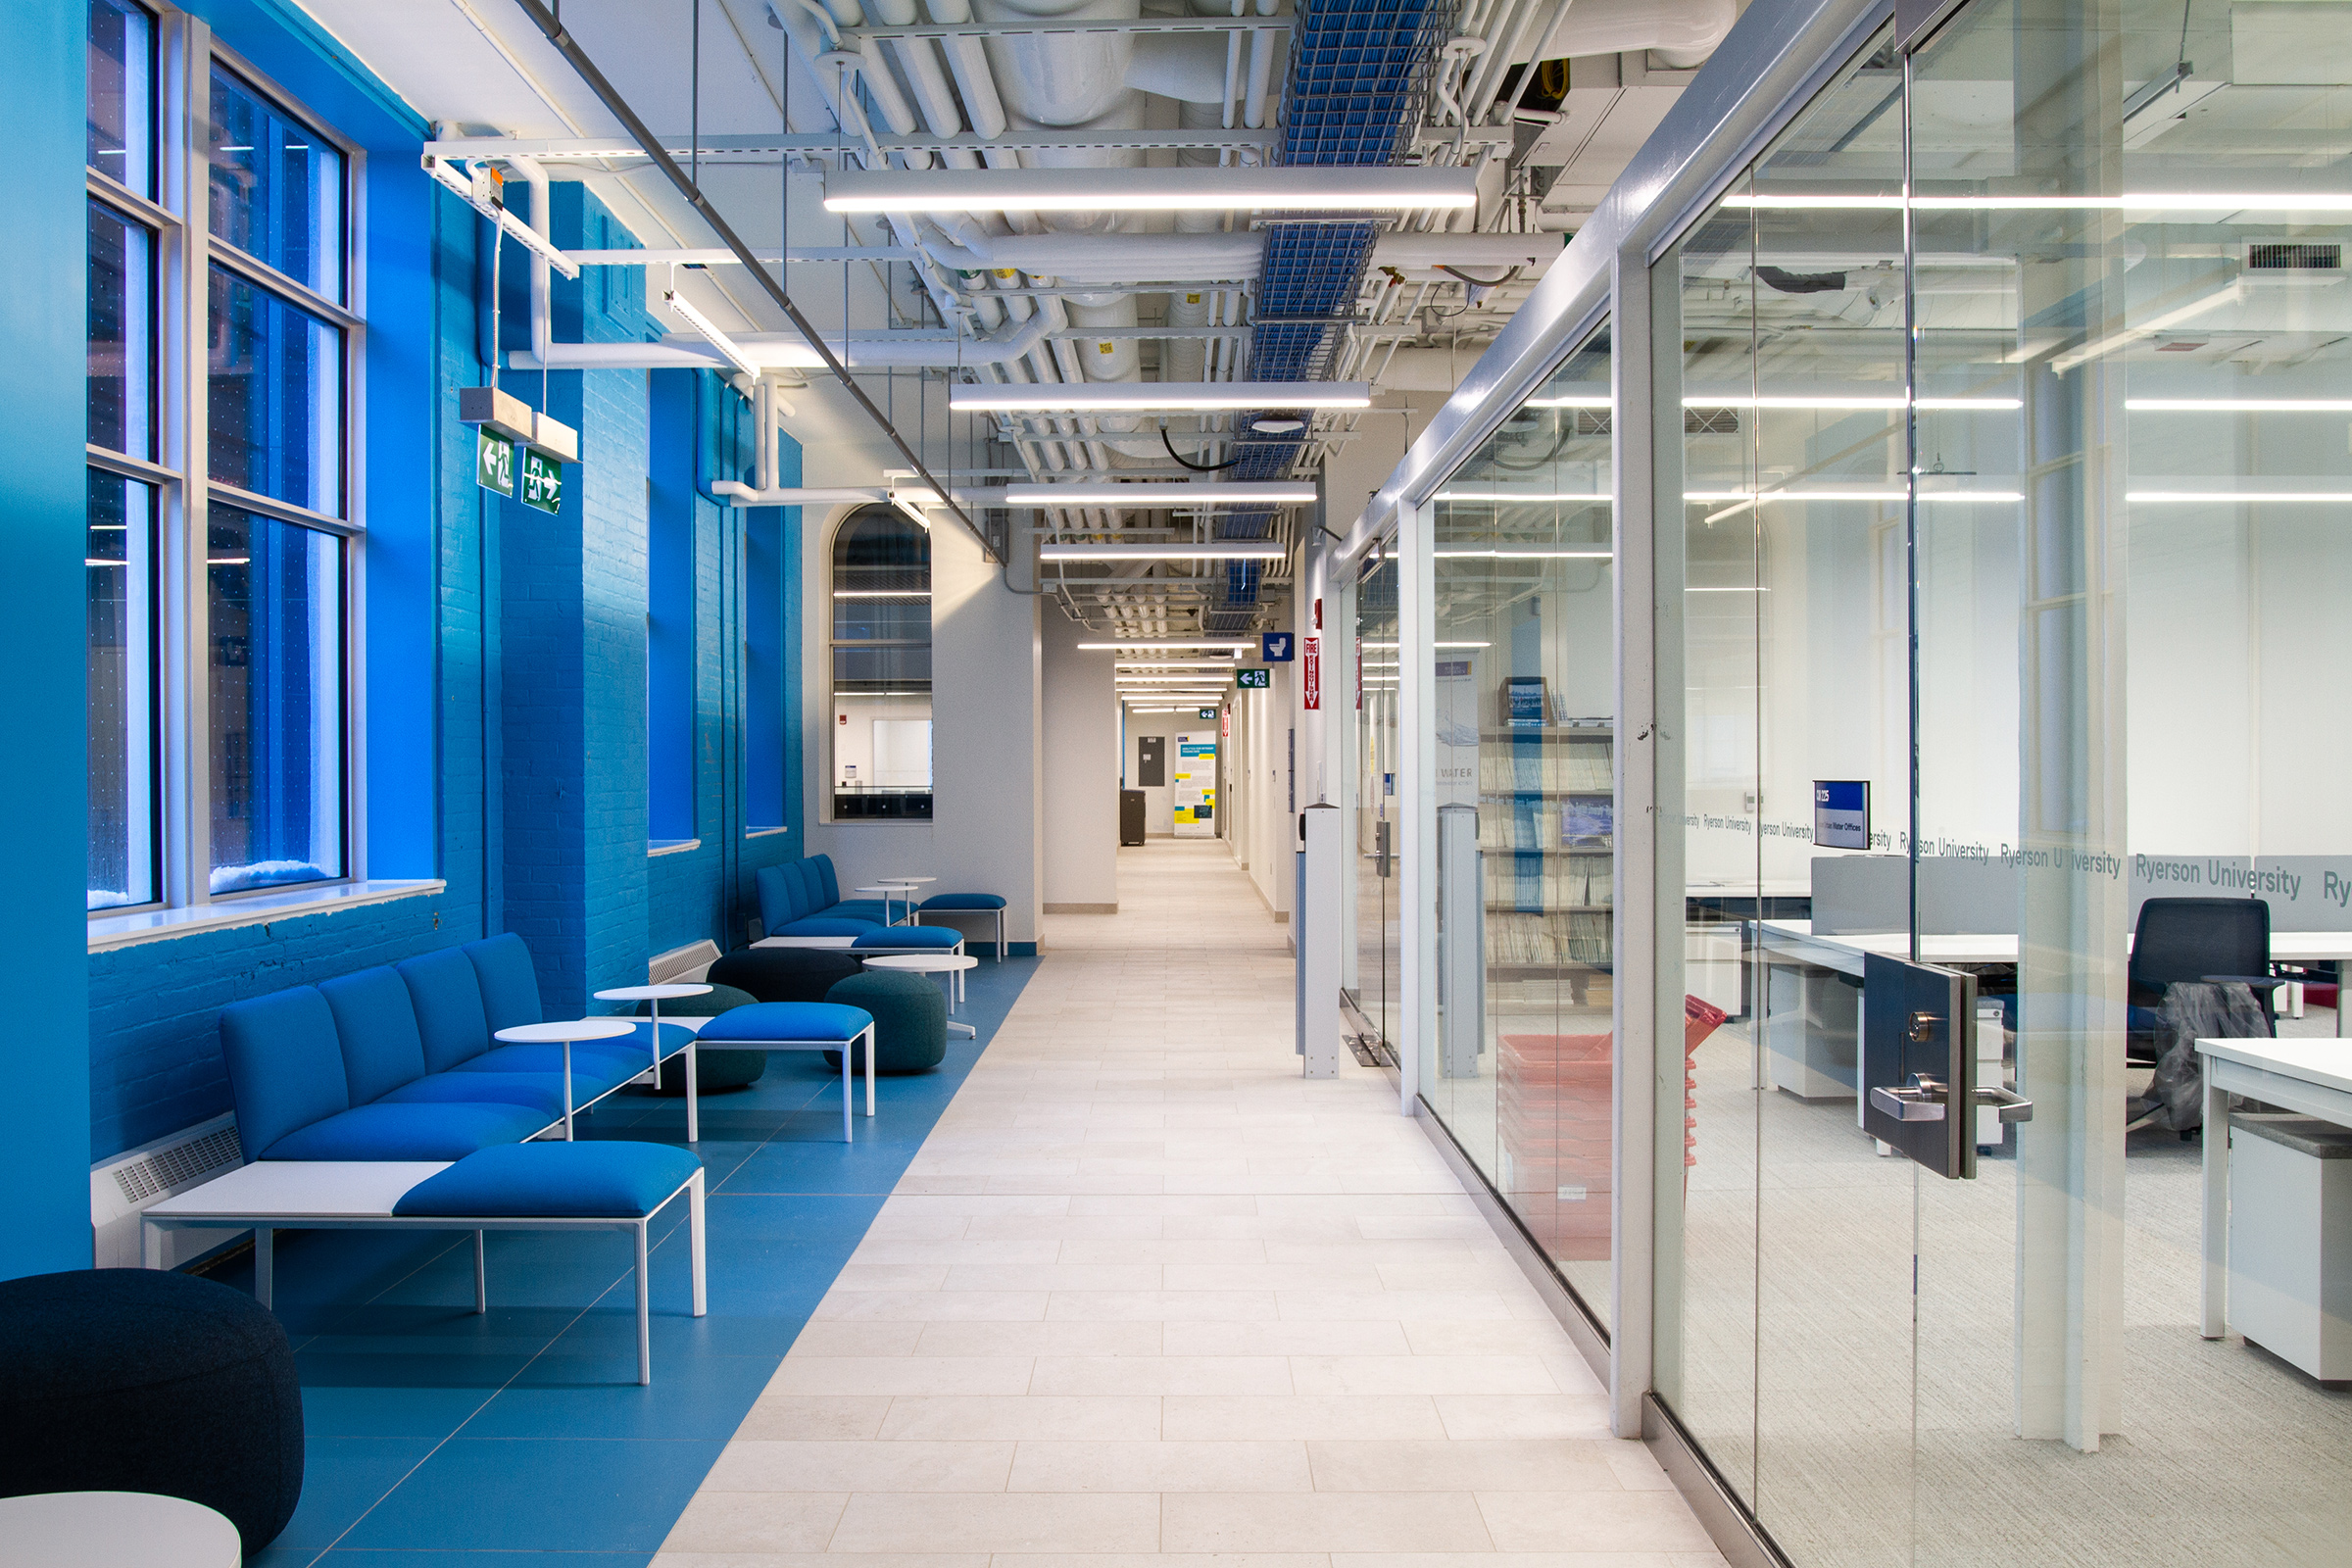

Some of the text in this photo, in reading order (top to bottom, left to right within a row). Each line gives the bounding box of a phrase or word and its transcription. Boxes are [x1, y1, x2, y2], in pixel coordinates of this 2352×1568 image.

[1305, 643, 1317, 654] FIRE
[1441, 767, 1473, 778] WATER
[1703, 813, 1752, 835] Ryerson University
[1760, 823, 1780, 838] yerson
[1782, 821, 1814, 843] University
[1870, 829, 1891, 852] ersity
[1899, 831, 1989, 866] Ryson University
[2000, 843, 2121, 880] Ryerson Uiversity
[2135, 853, 2200, 883] Ryerson
[2208, 858, 2301, 901] University
